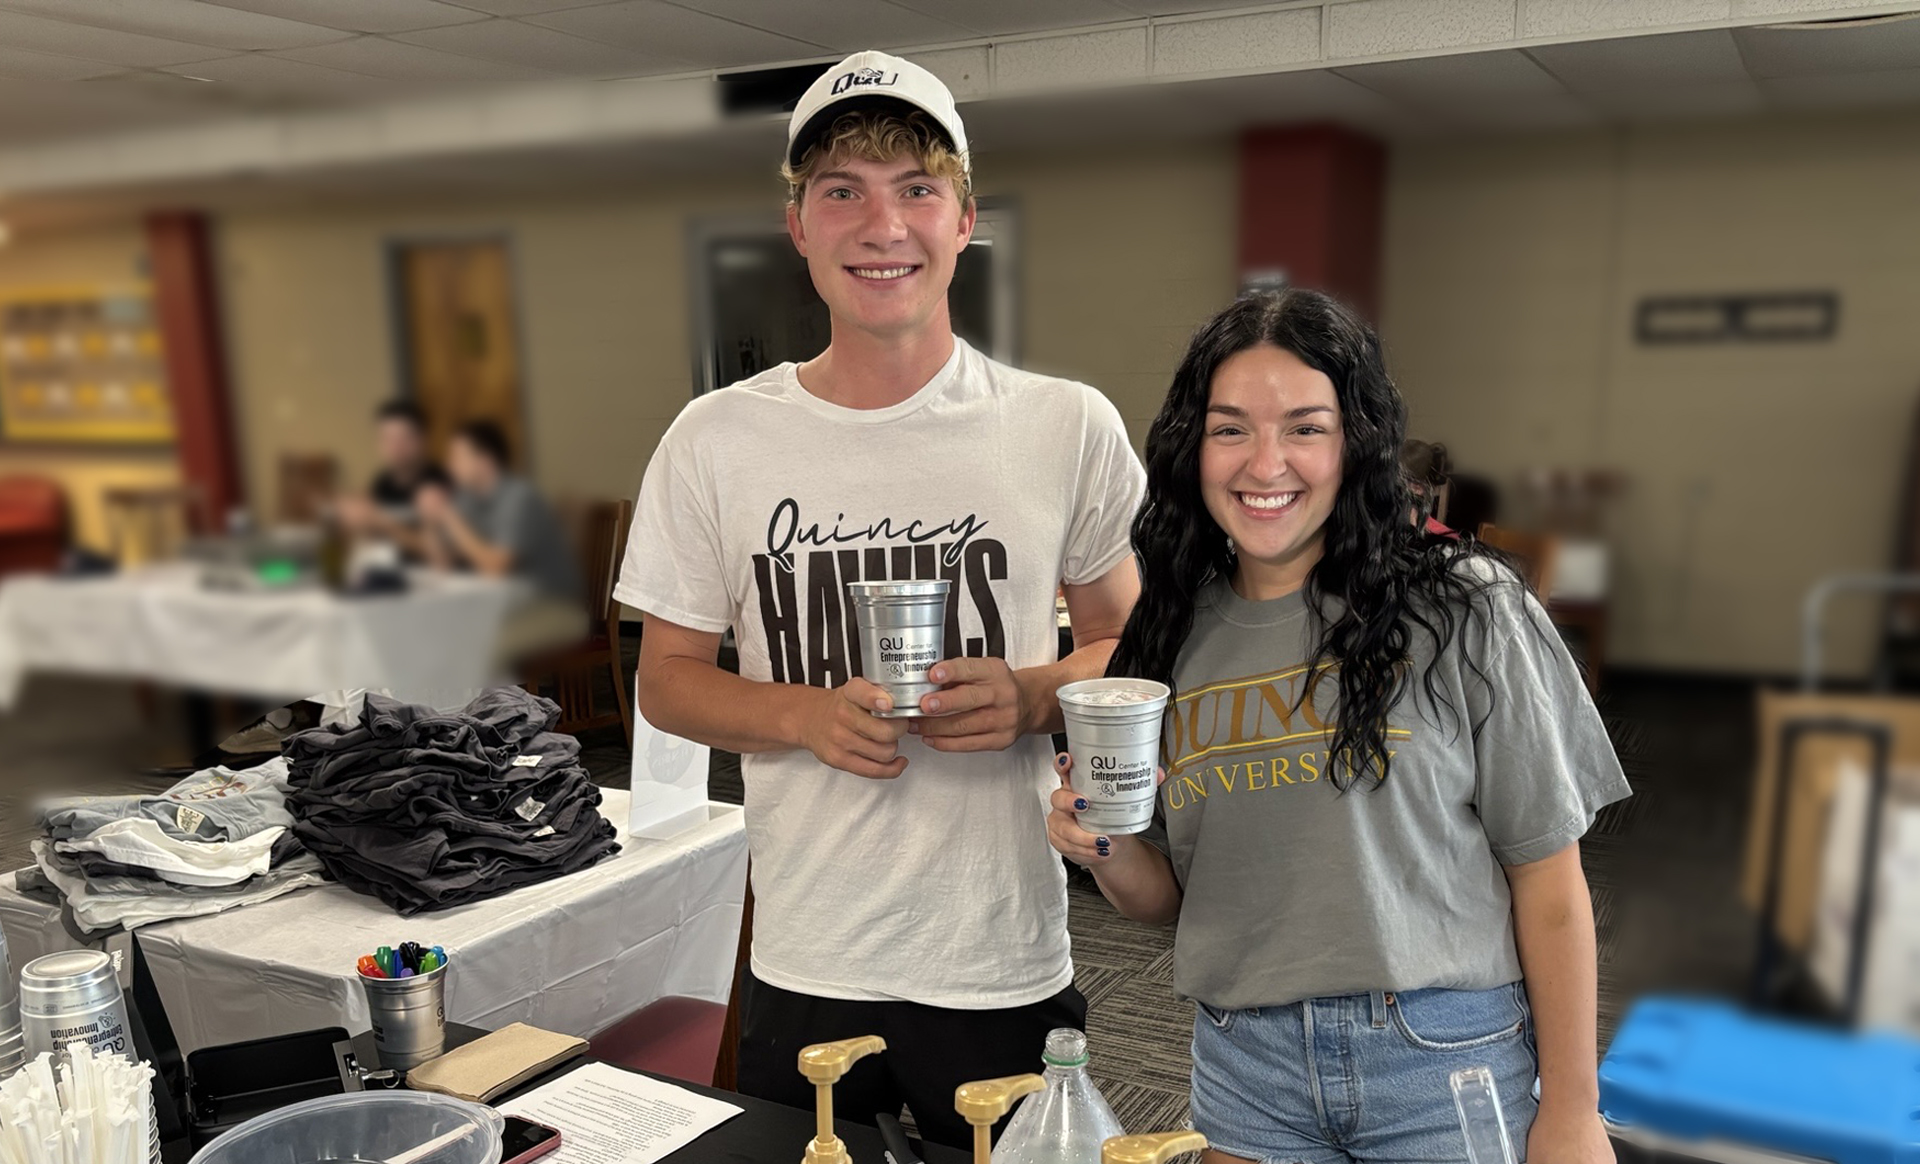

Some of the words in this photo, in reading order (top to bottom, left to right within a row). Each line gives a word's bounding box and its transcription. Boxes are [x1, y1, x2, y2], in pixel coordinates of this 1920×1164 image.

[767, 497, 989, 572] Quincy
[880, 637, 903, 650] QU
[881, 650, 937, 663] Entrepreneurship
[904, 661, 937, 673] Innovat
[1163, 660, 1404, 776] QUINC
[1091, 756, 1116, 770] QU
[1118, 762, 1139, 770] Center
[1092, 767, 1151, 782] Entrepreneurship
[1168, 748, 1397, 809] UNVERSTY
[1116, 778, 1151, 792] Innovation
[50, 1022, 99, 1039] Innovation
